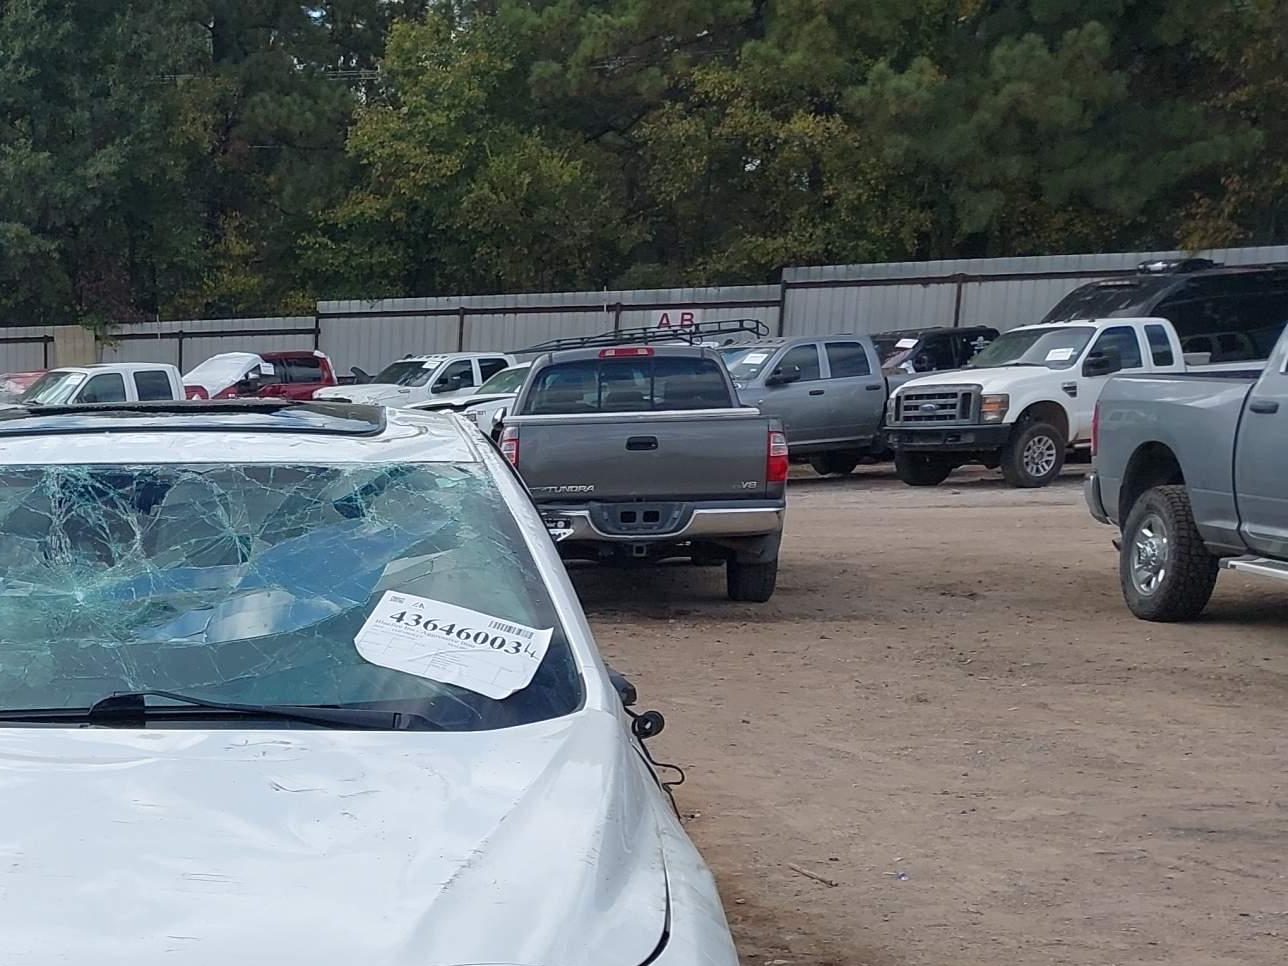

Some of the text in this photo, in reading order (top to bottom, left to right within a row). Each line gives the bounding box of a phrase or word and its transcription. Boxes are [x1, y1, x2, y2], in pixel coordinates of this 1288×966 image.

[657, 312, 695, 329] A B
[544, 485, 595, 493] TUNDRA
[741, 481, 757, 489] V8
[389, 610, 522, 655] 43646003
